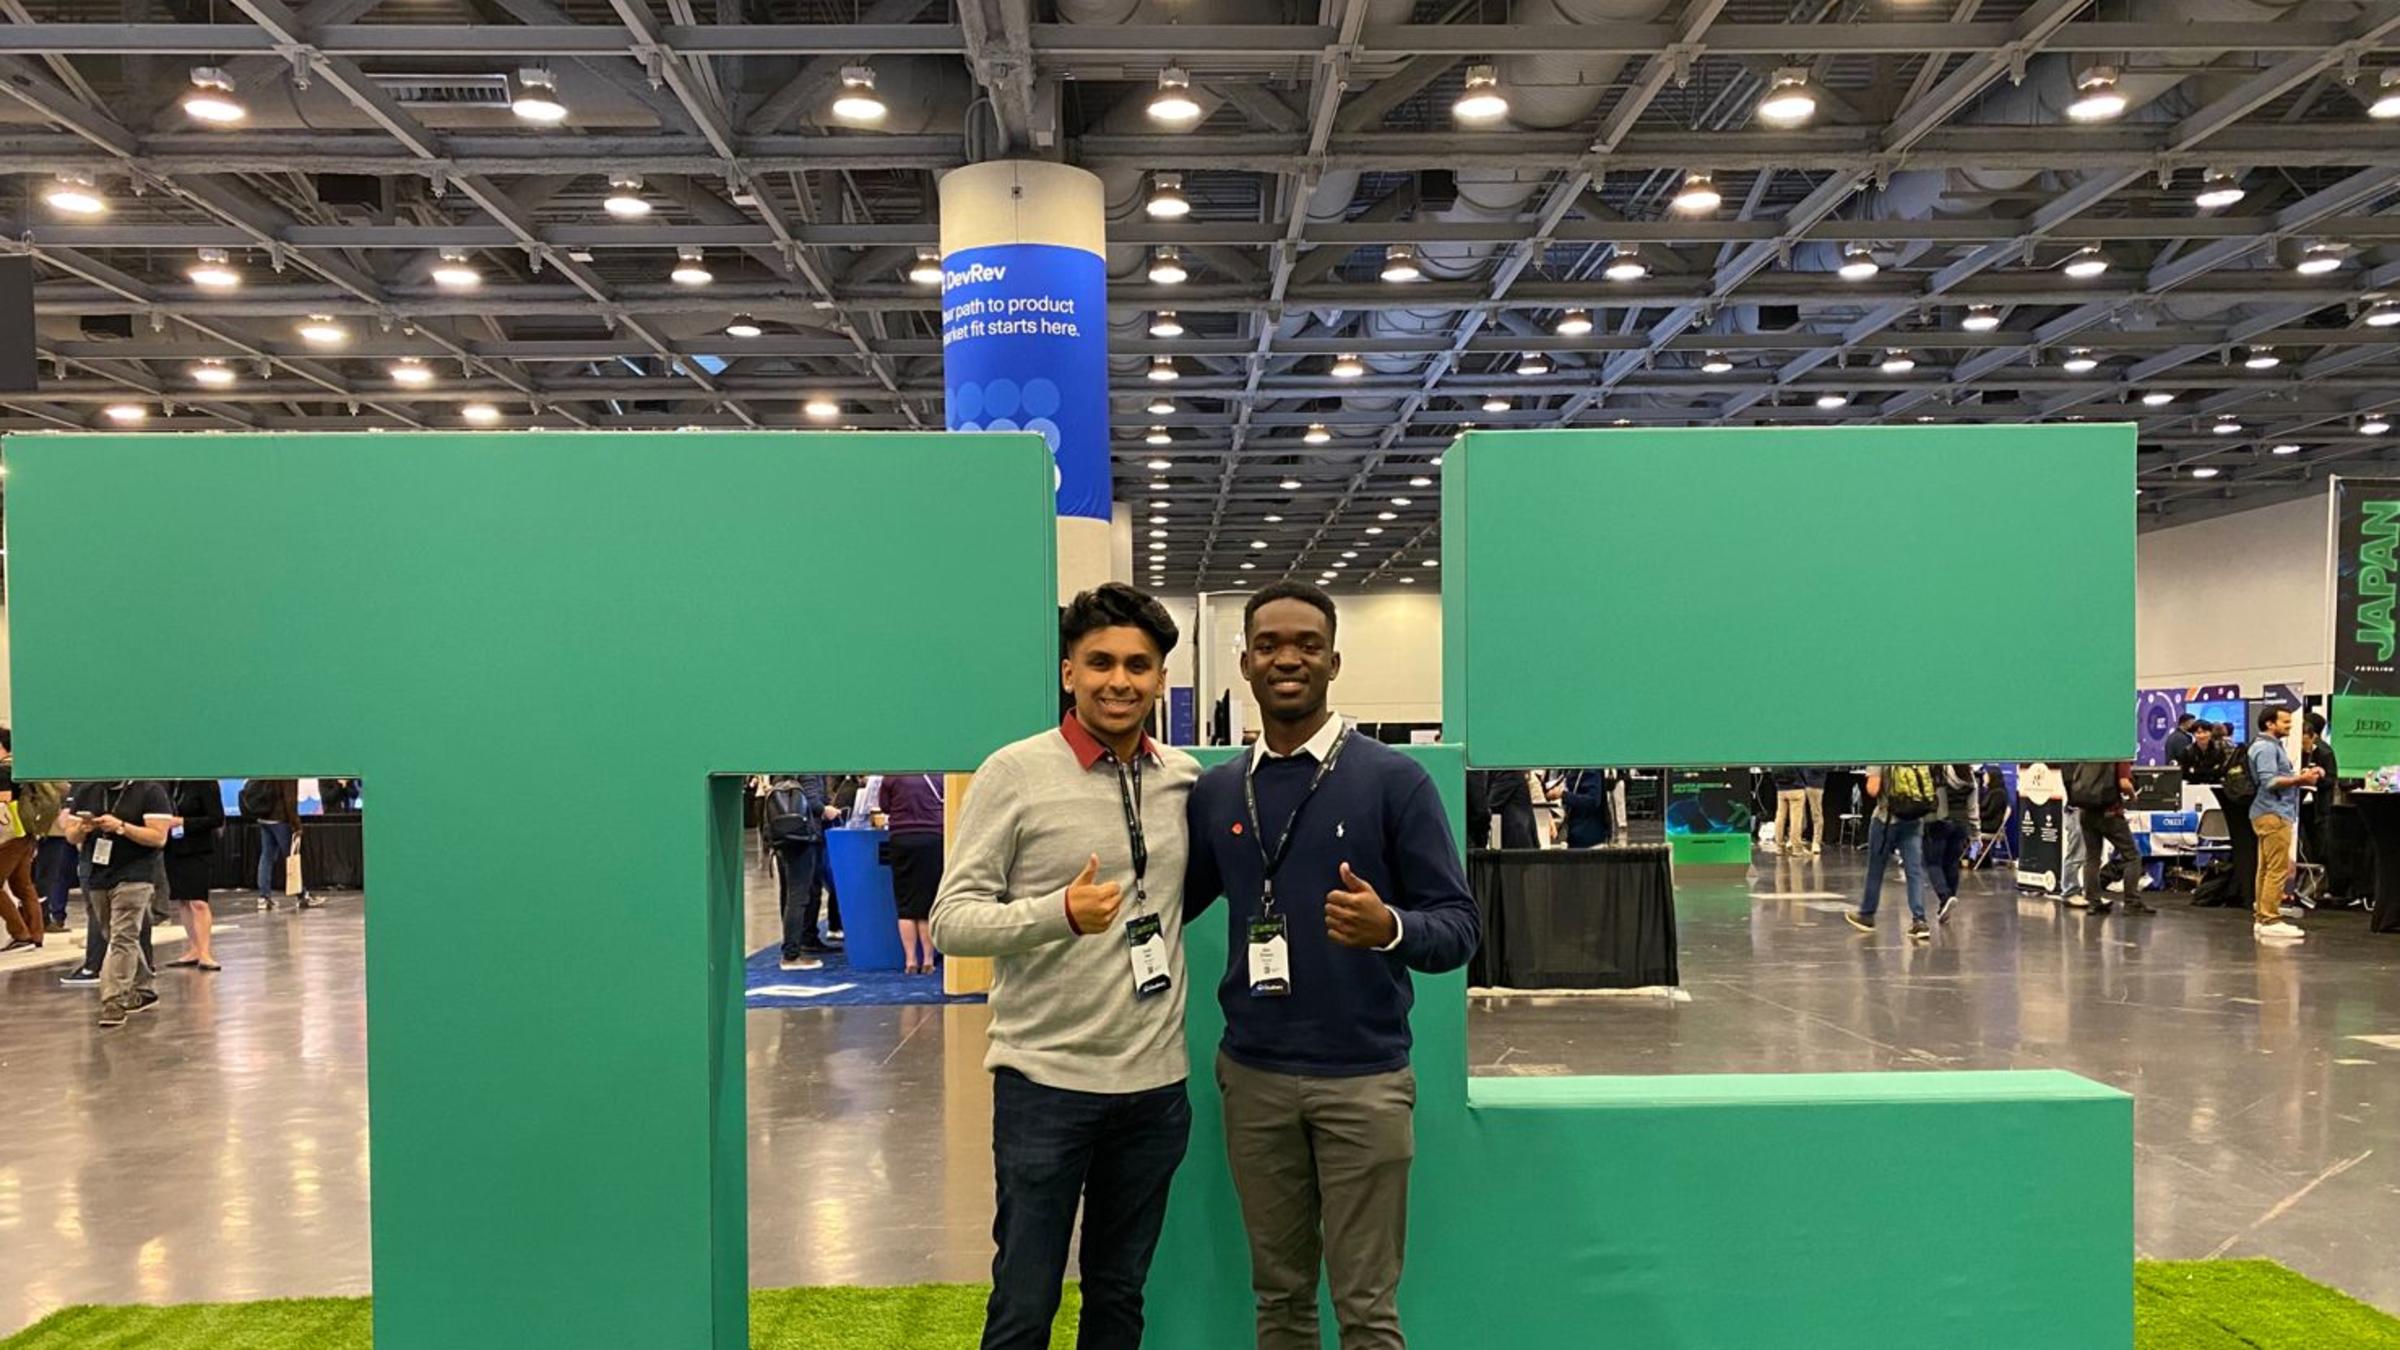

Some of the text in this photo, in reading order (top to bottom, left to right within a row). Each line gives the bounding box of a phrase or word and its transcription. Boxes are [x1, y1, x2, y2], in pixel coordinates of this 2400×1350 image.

[946, 263, 1006, 291] DevRev
[956, 298, 985, 322] path
[988, 298, 1004, 313] to
[1008, 295, 1075, 316] product
[970, 320, 985, 337] fit
[988, 318, 1038, 335] starts
[1041, 317, 1081, 337] here.
[2356, 501, 2400, 661] JAPAN
